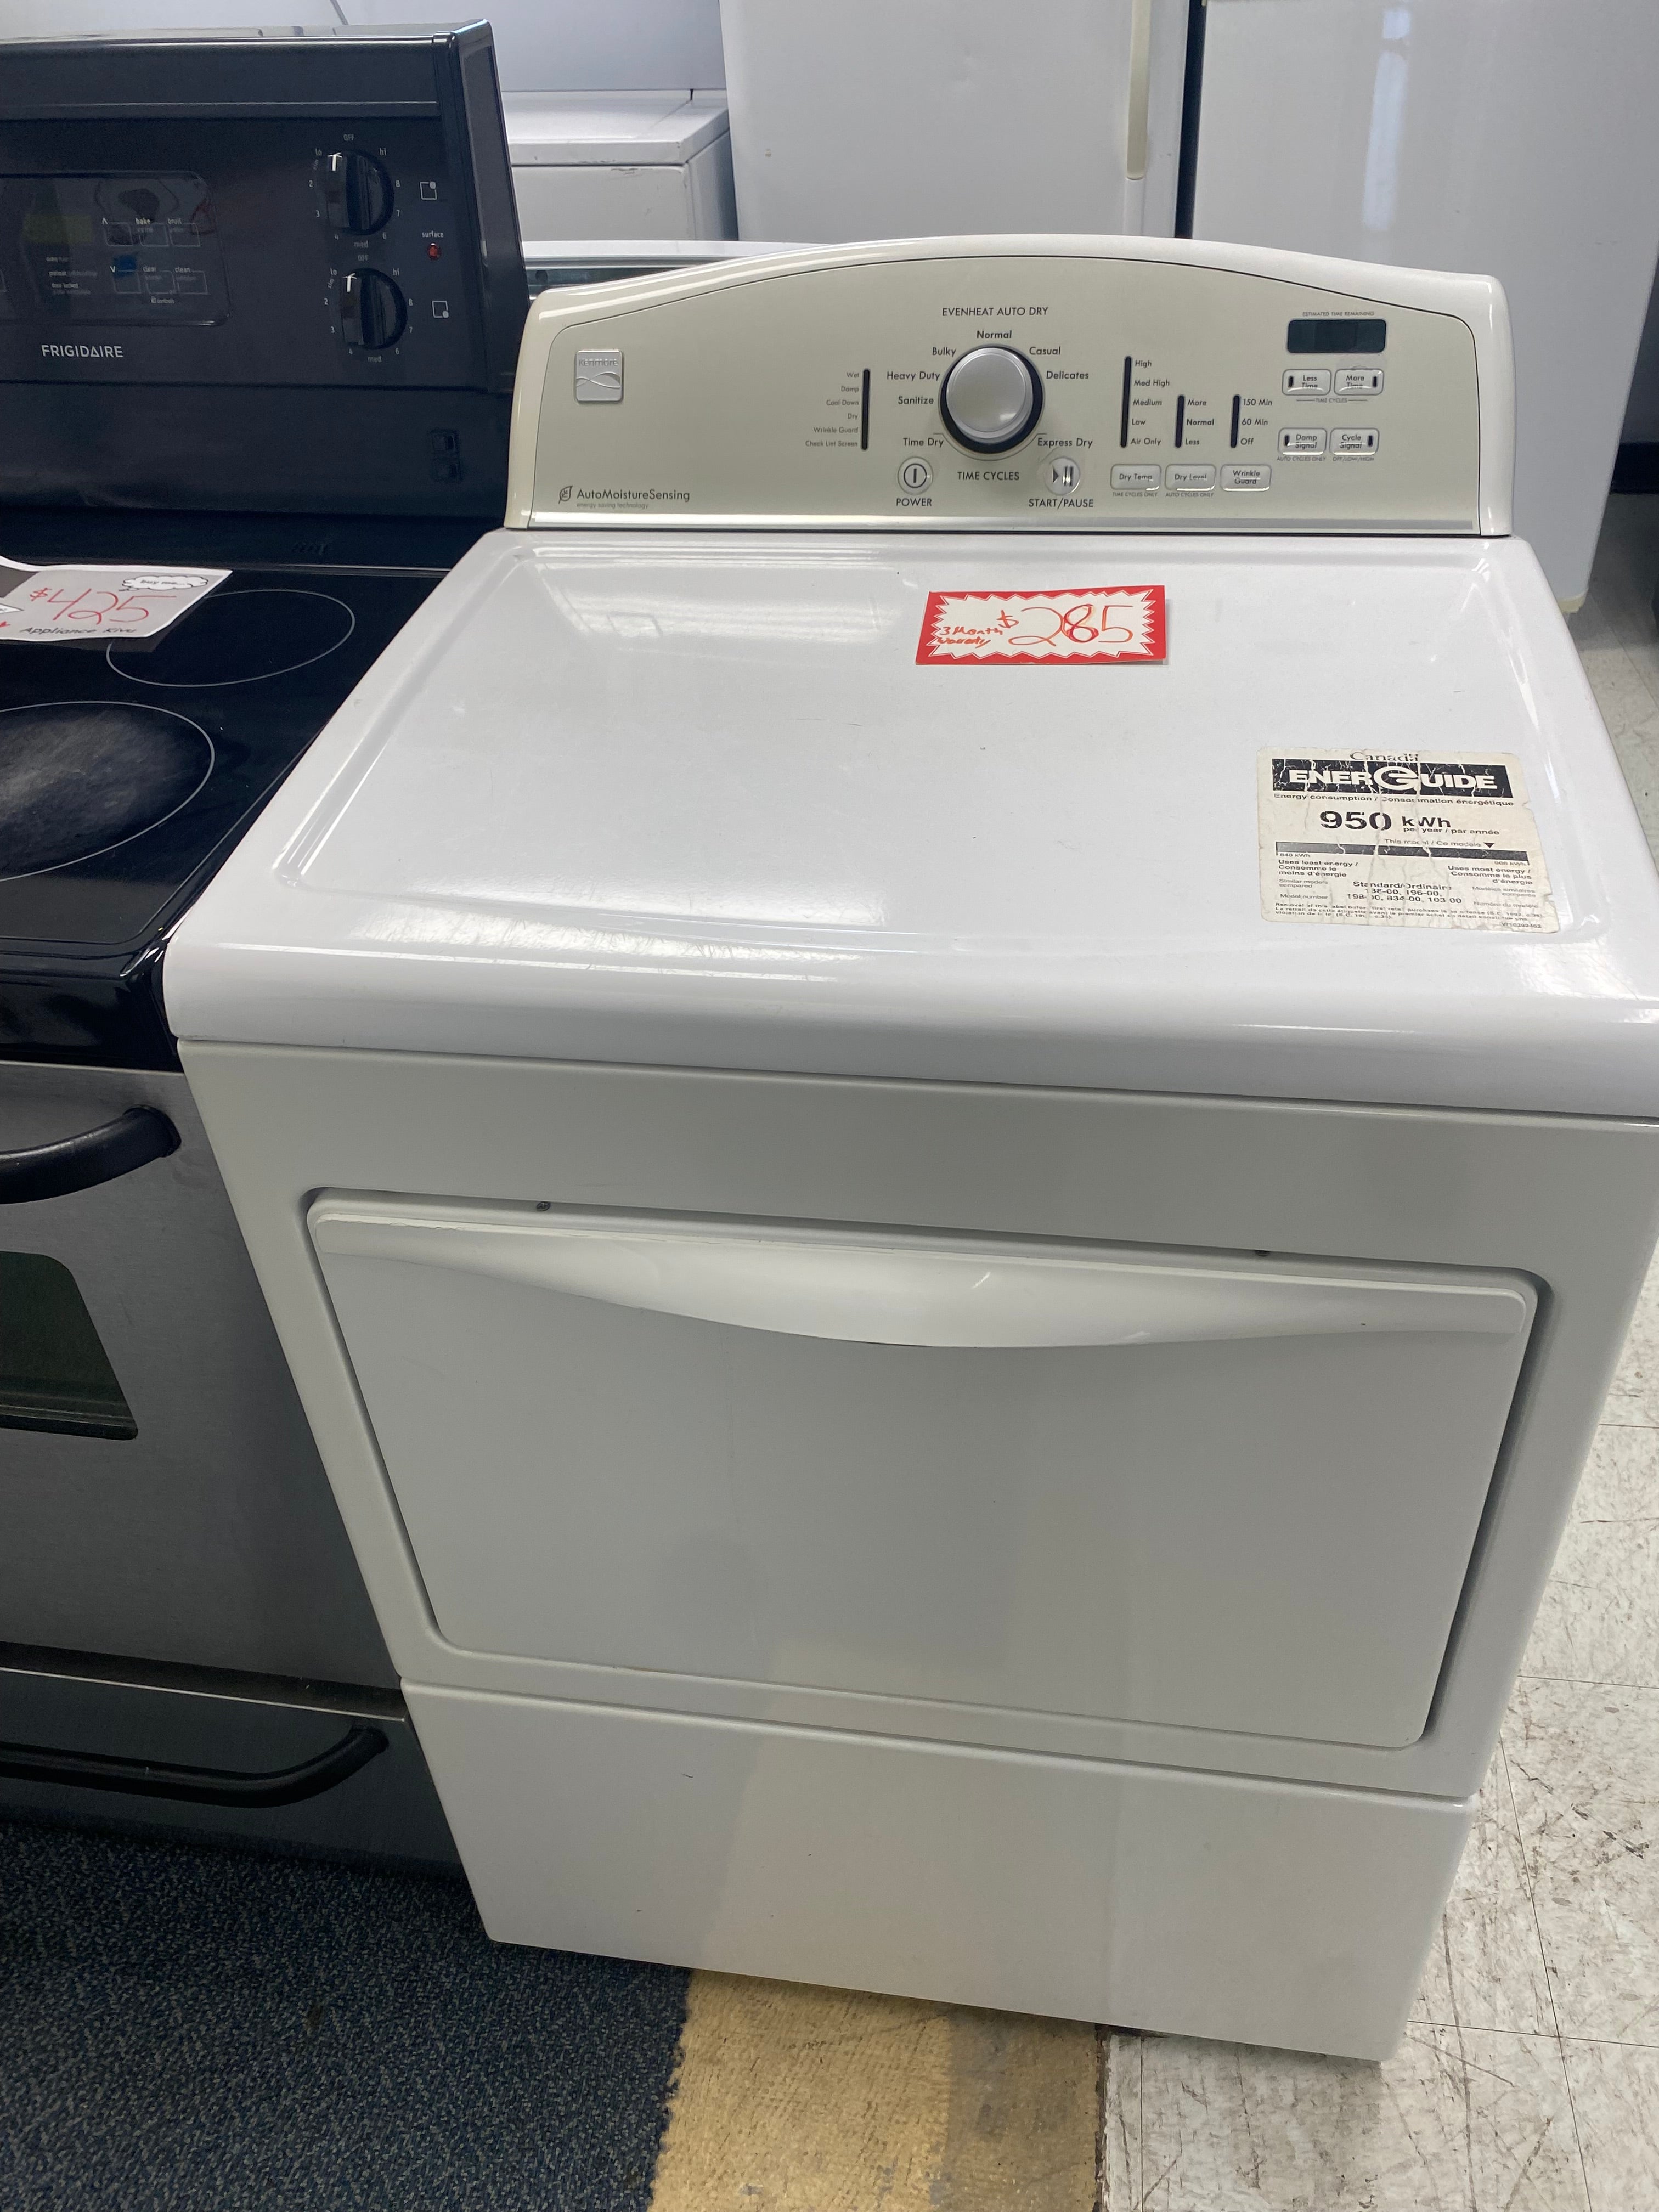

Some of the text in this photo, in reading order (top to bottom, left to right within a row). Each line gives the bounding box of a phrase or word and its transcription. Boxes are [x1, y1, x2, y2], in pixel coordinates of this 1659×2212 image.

[379, 148, 387, 156] hi
[942, 307, 1048, 316] EVENHEAT AUTO DRY
[977, 330, 1012, 339] Normal
[41, 345, 123, 358] FRIGIDAIRE
[932, 347, 956, 357] Bulky
[1029, 347, 1061, 356] Casual
[1135, 360, 1152, 368] High
[887, 371, 940, 381] Heavy Duty
[1046, 371, 1089, 380] Delicates
[1153, 379, 1170, 388] High
[898, 396, 934, 405] Sanitize
[903, 438, 944, 448] Time Dry
[1037, 438, 1093, 448] Express Dry
[1144, 438, 1161, 446] Only
[957, 472, 1019, 481] TIME CYCLES
[1119, 473, 1131, 482] Dry
[1175, 473, 1187, 482] Dry
[577, 489, 690, 502] AutoMoistureSensing
[896, 498, 932, 507] POWER
[1028, 499, 1093, 509] START/PAUSE
[939, 627, 951, 635] 3
[1289, 766, 1497, 791] ENERGUIDE
[1456, 798, 1514, 806] énergétique
[1319, 811, 1451, 831] 950 kWh
